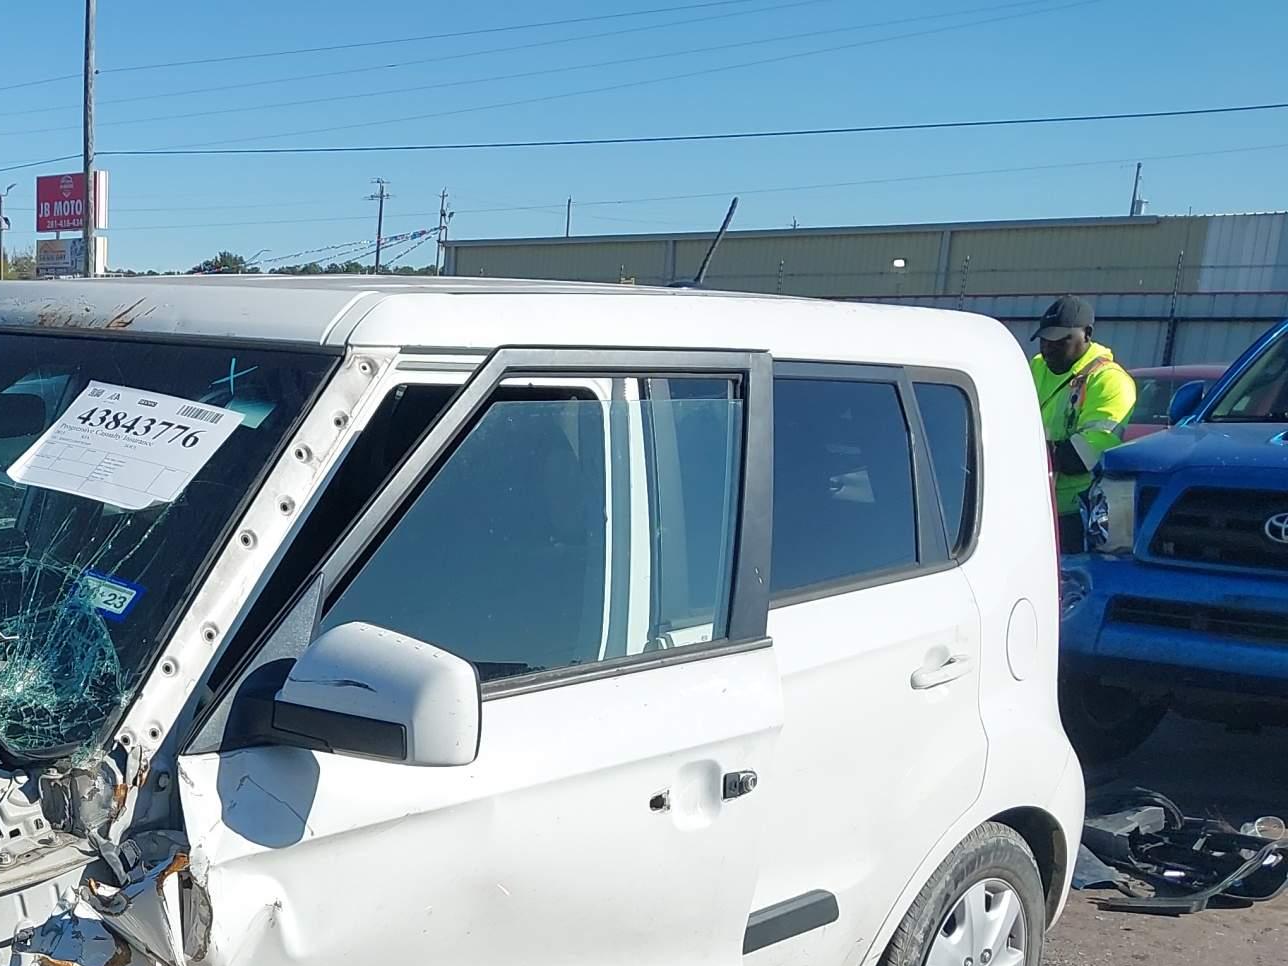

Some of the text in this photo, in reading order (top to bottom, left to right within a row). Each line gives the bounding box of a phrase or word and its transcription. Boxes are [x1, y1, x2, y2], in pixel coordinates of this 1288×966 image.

[39, 199, 84, 218] JB MOTO
[76, 406, 207, 448] 43843776
[103, 593, 127, 609] 23
